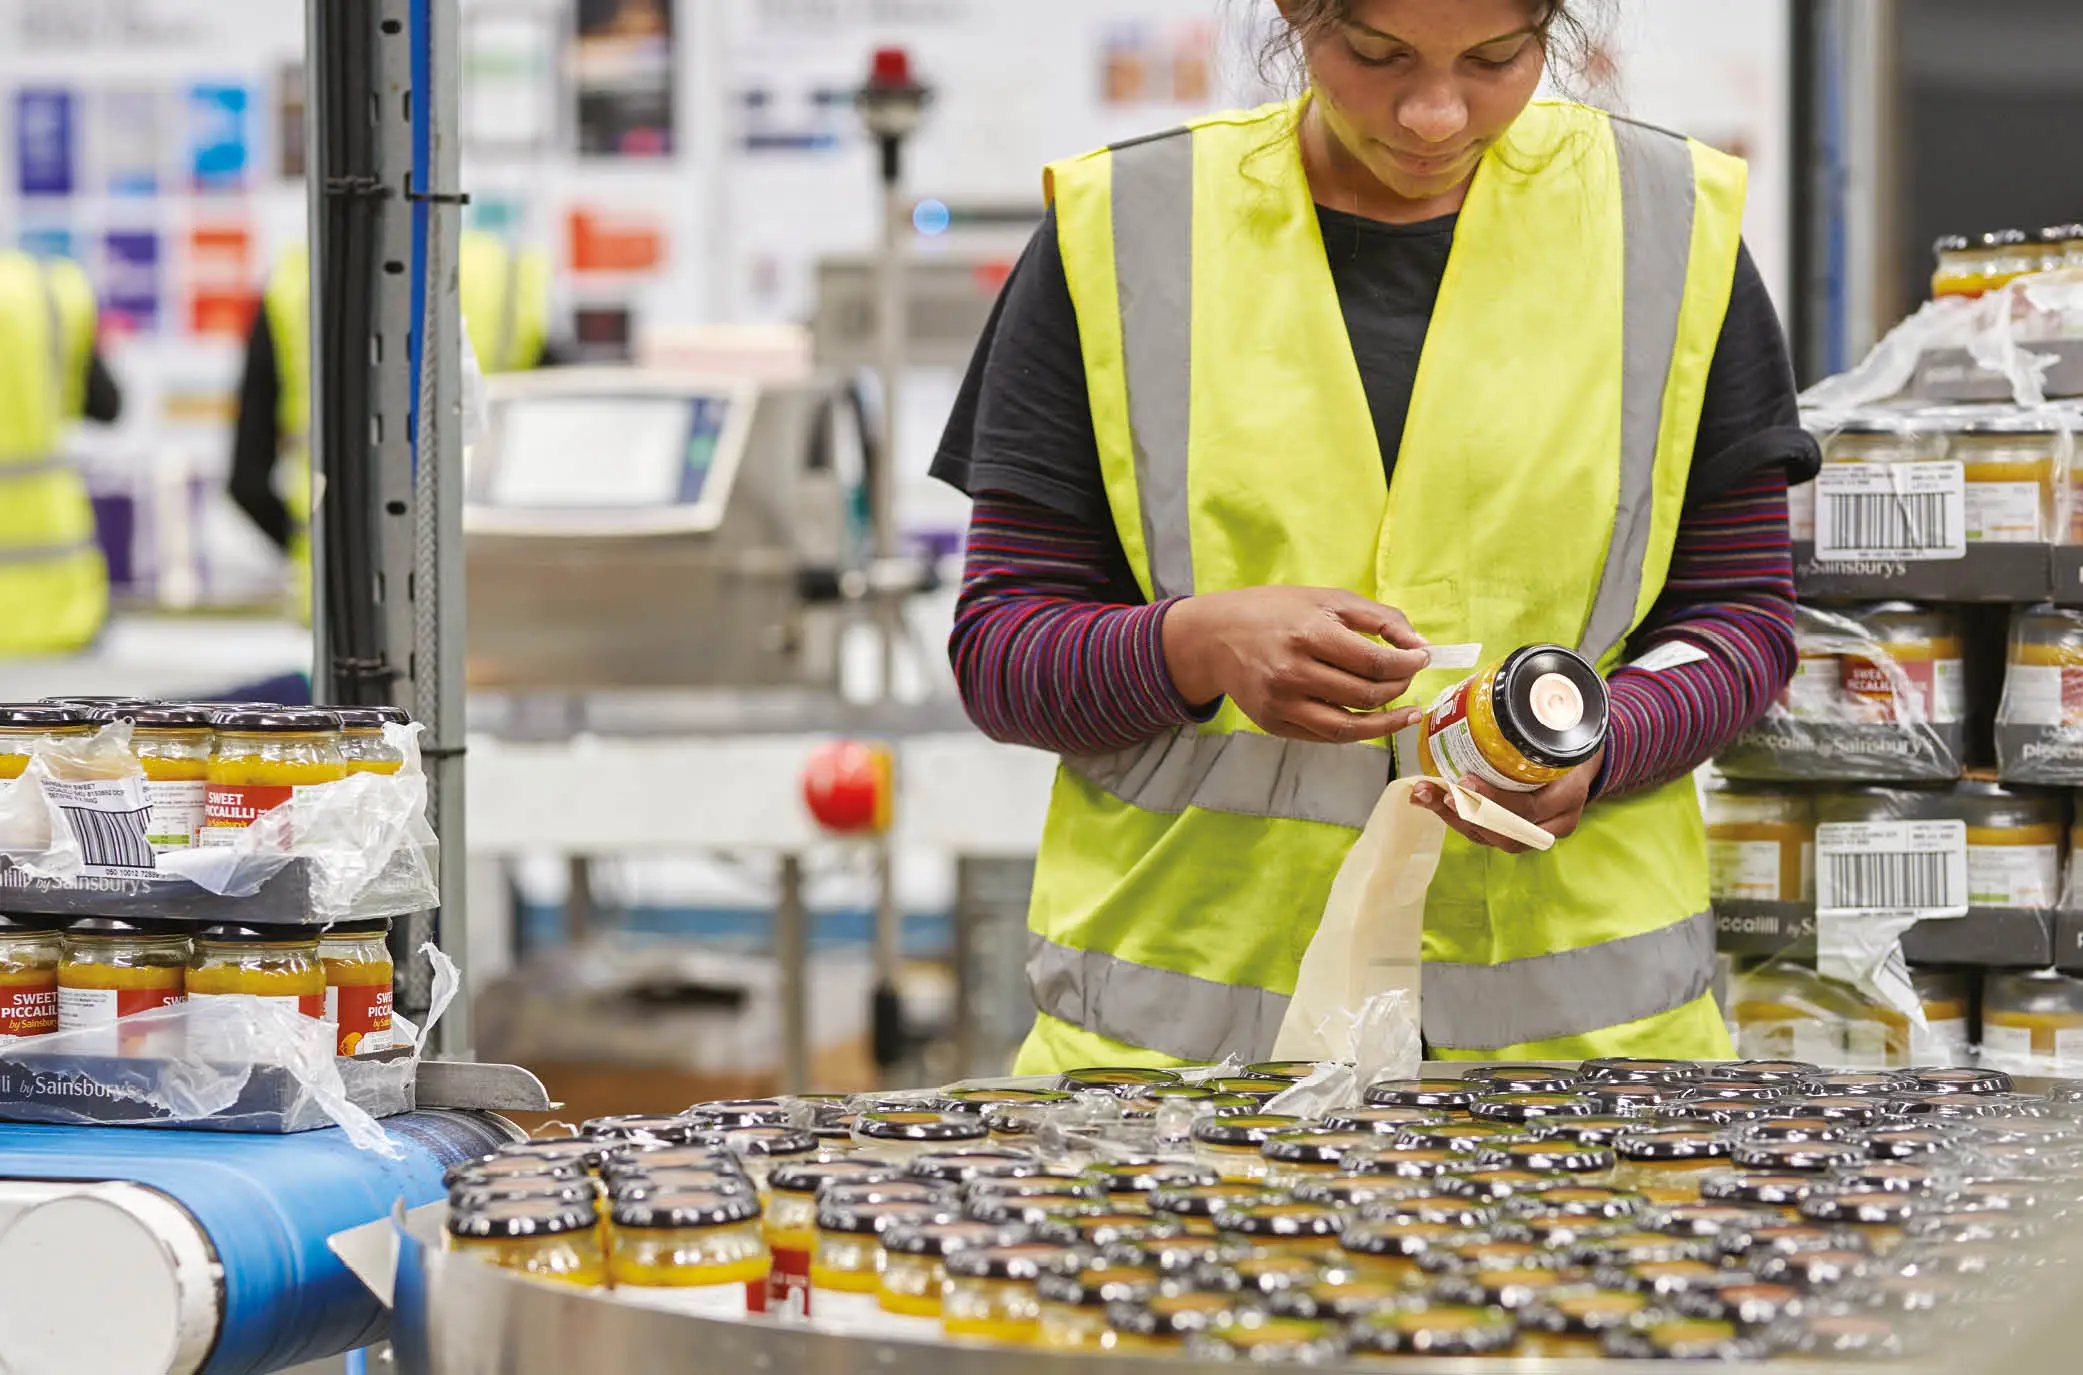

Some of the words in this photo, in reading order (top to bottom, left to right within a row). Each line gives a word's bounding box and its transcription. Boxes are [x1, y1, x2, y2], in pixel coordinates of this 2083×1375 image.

[1808, 557, 1906, 579] Sainsburys
[73, 783, 95, 791] SWEET
[208, 792, 244, 805] SWEET
[36, 878, 51, 893] by
[51, 876, 152, 897] Sainsburys
[13, 992, 58, 1005] SWEET
[8, 1019, 21, 1031] by
[20, 1080, 34, 1098] by
